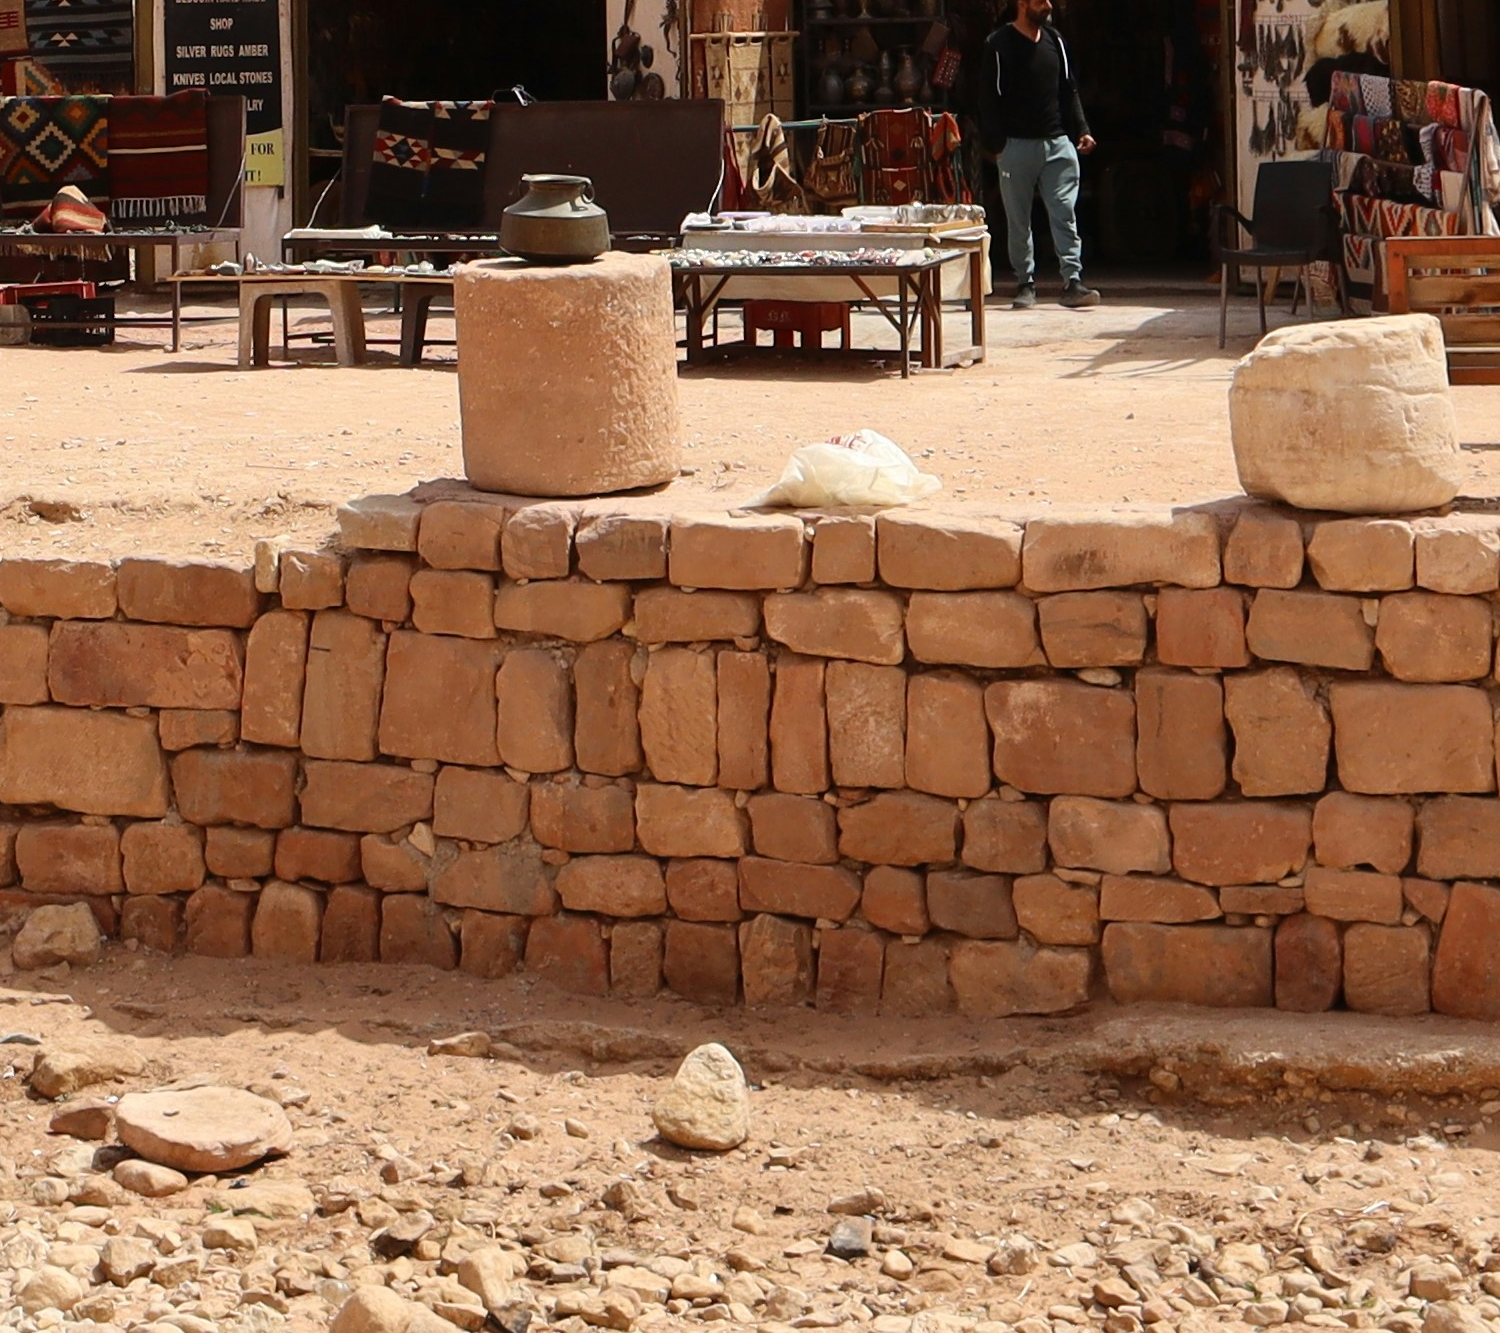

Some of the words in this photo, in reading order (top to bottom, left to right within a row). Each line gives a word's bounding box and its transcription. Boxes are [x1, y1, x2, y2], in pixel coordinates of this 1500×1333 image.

[209, 17, 233, 31] SHOP
[176, 45, 207, 59] SILVER
[210, 45, 234, 58] RUGS
[238, 44, 268, 57] AMBER
[173, 72, 205, 86] KNIVES
[209, 72, 237, 85] LOCAL
[239, 71, 273, 84] STONES
[246, 99, 264, 111] LRY
[251, 142, 275, 155] FOR
